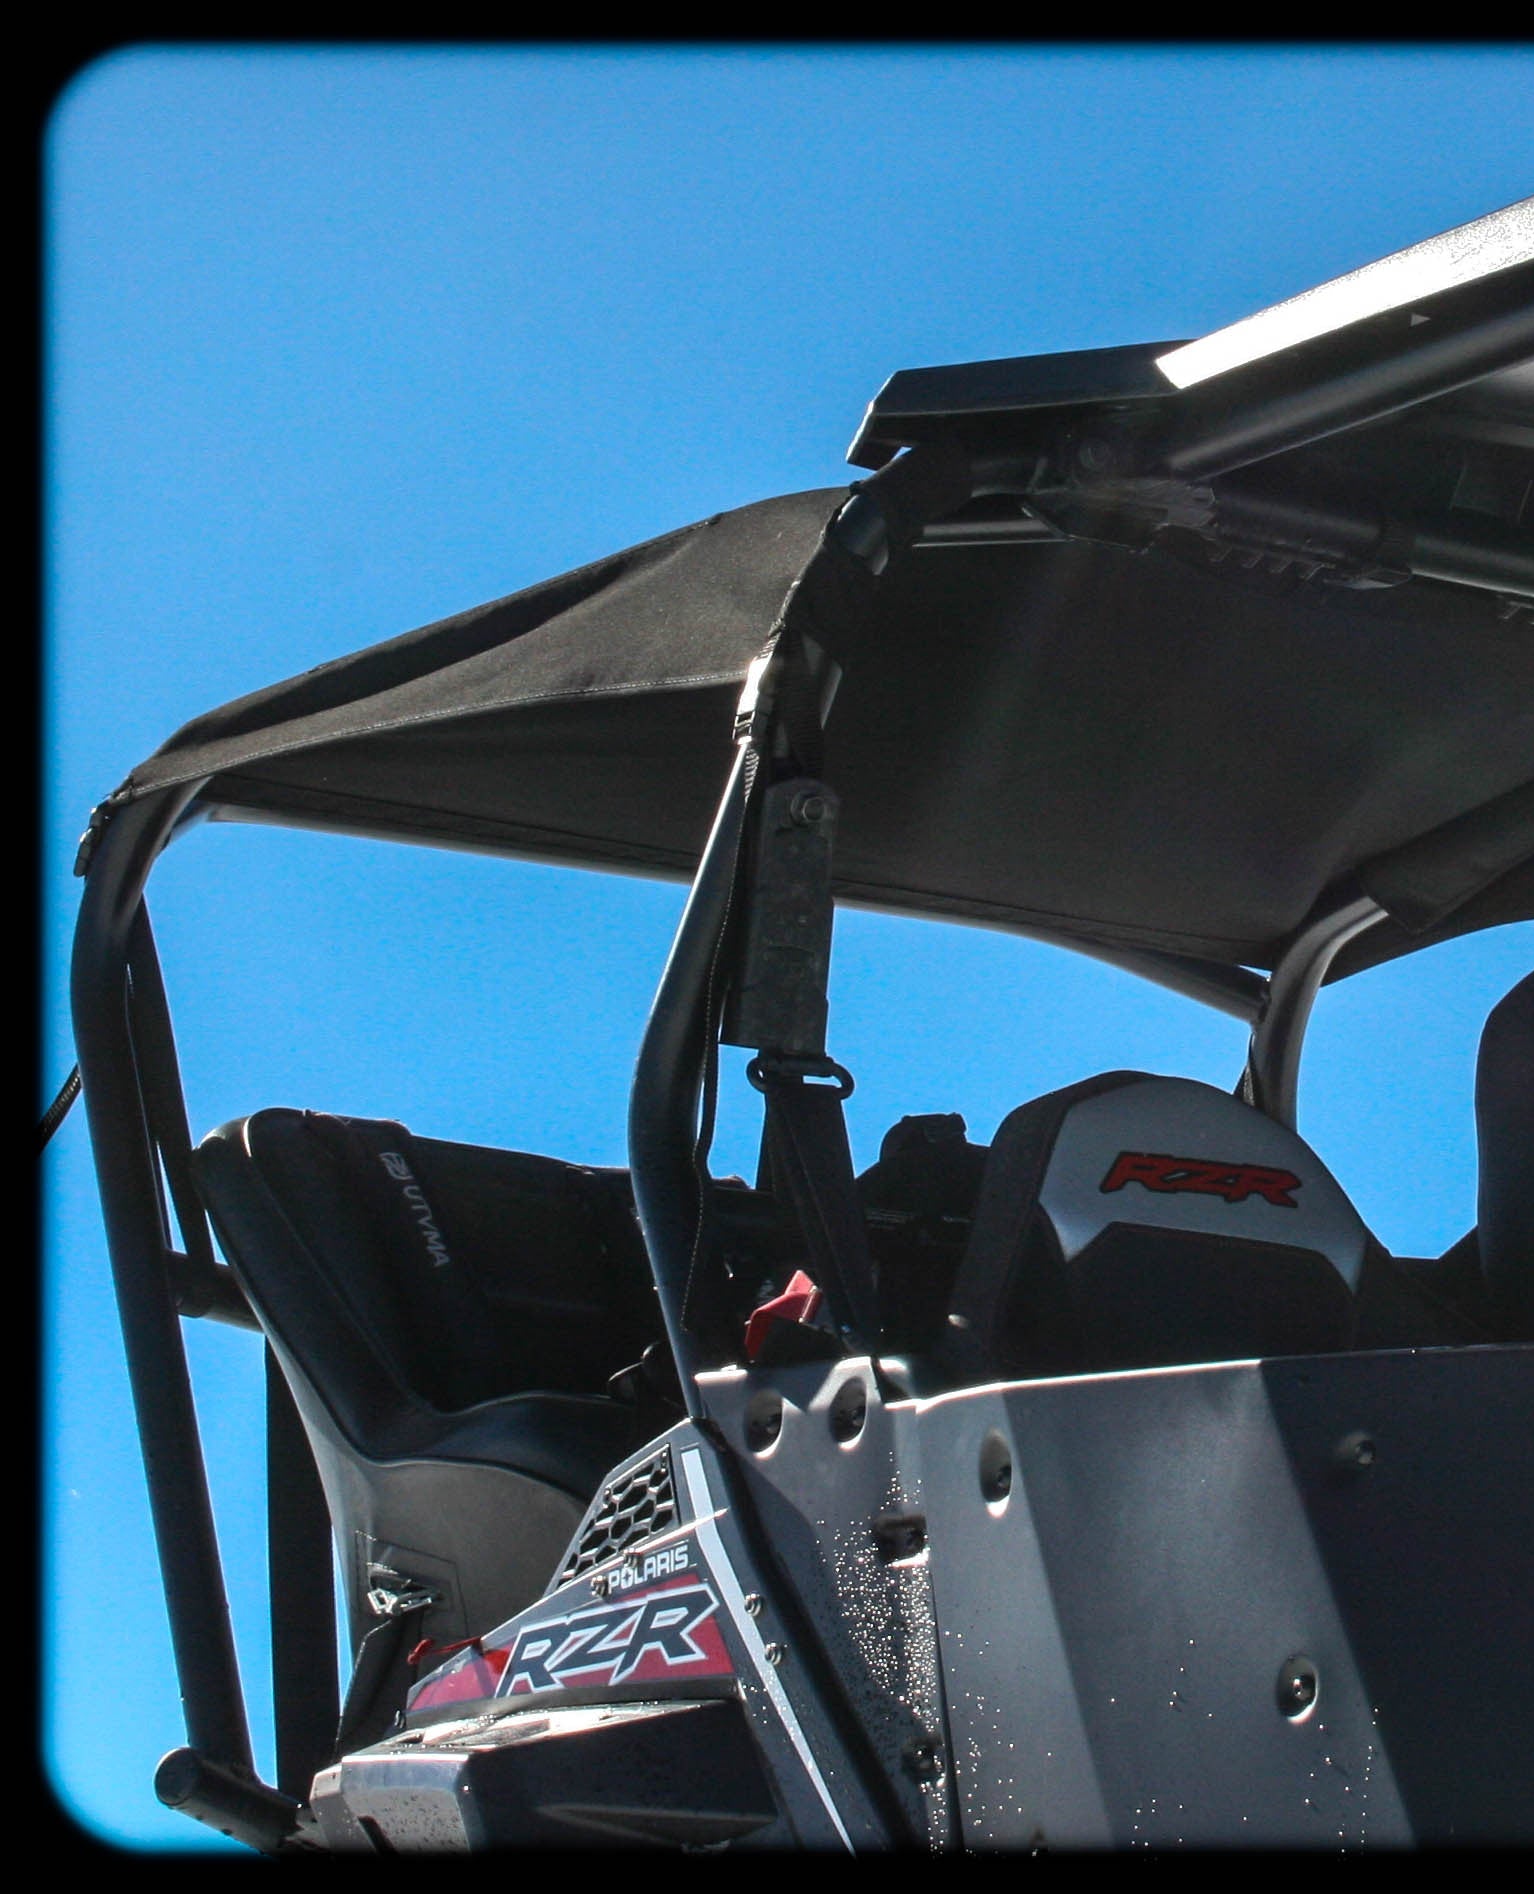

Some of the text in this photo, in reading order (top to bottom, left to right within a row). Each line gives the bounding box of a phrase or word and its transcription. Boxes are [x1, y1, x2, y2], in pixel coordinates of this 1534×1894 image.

[1101, 1150, 1302, 1208] RZR
[608, 1545, 689, 1594] POLARIS
[494, 1584, 720, 1699] RZR
